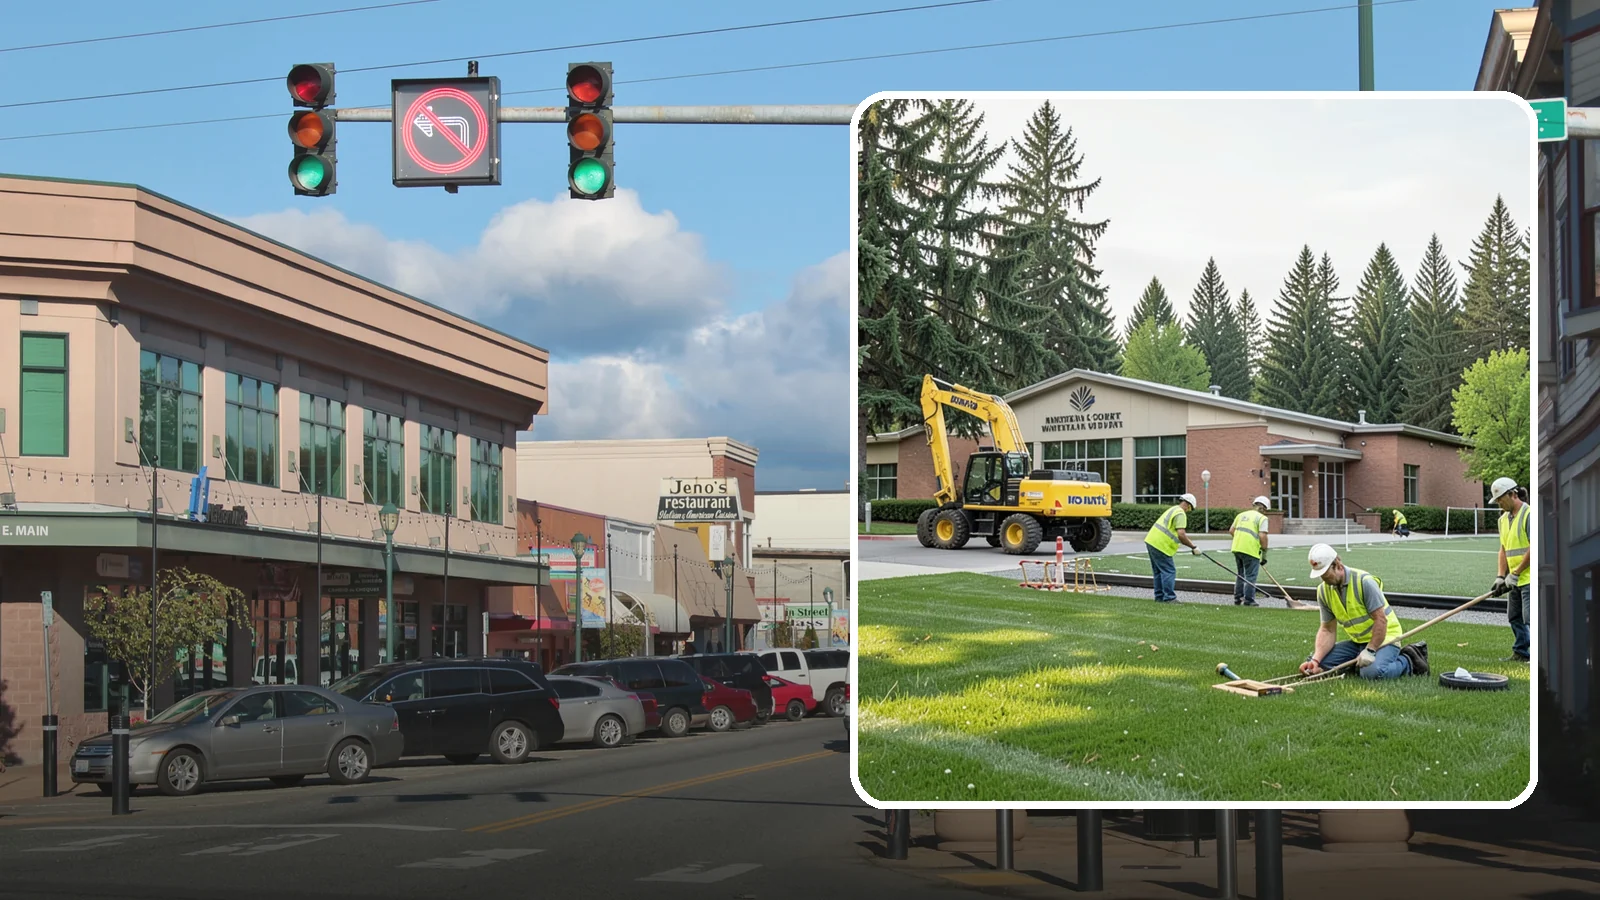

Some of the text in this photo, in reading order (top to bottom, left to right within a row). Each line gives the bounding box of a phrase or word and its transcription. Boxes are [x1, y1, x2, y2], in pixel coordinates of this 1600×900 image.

[670, 480, 727, 494] Jeno's
[665, 497, 731, 509] restaurant
[658, 510, 681, 519] Italian
[686, 510, 714, 519] American
[715, 509, 737, 519] Cuisine
[2, 525, 49, 536] E. MAIN
[786, 608, 828, 616] in Street
